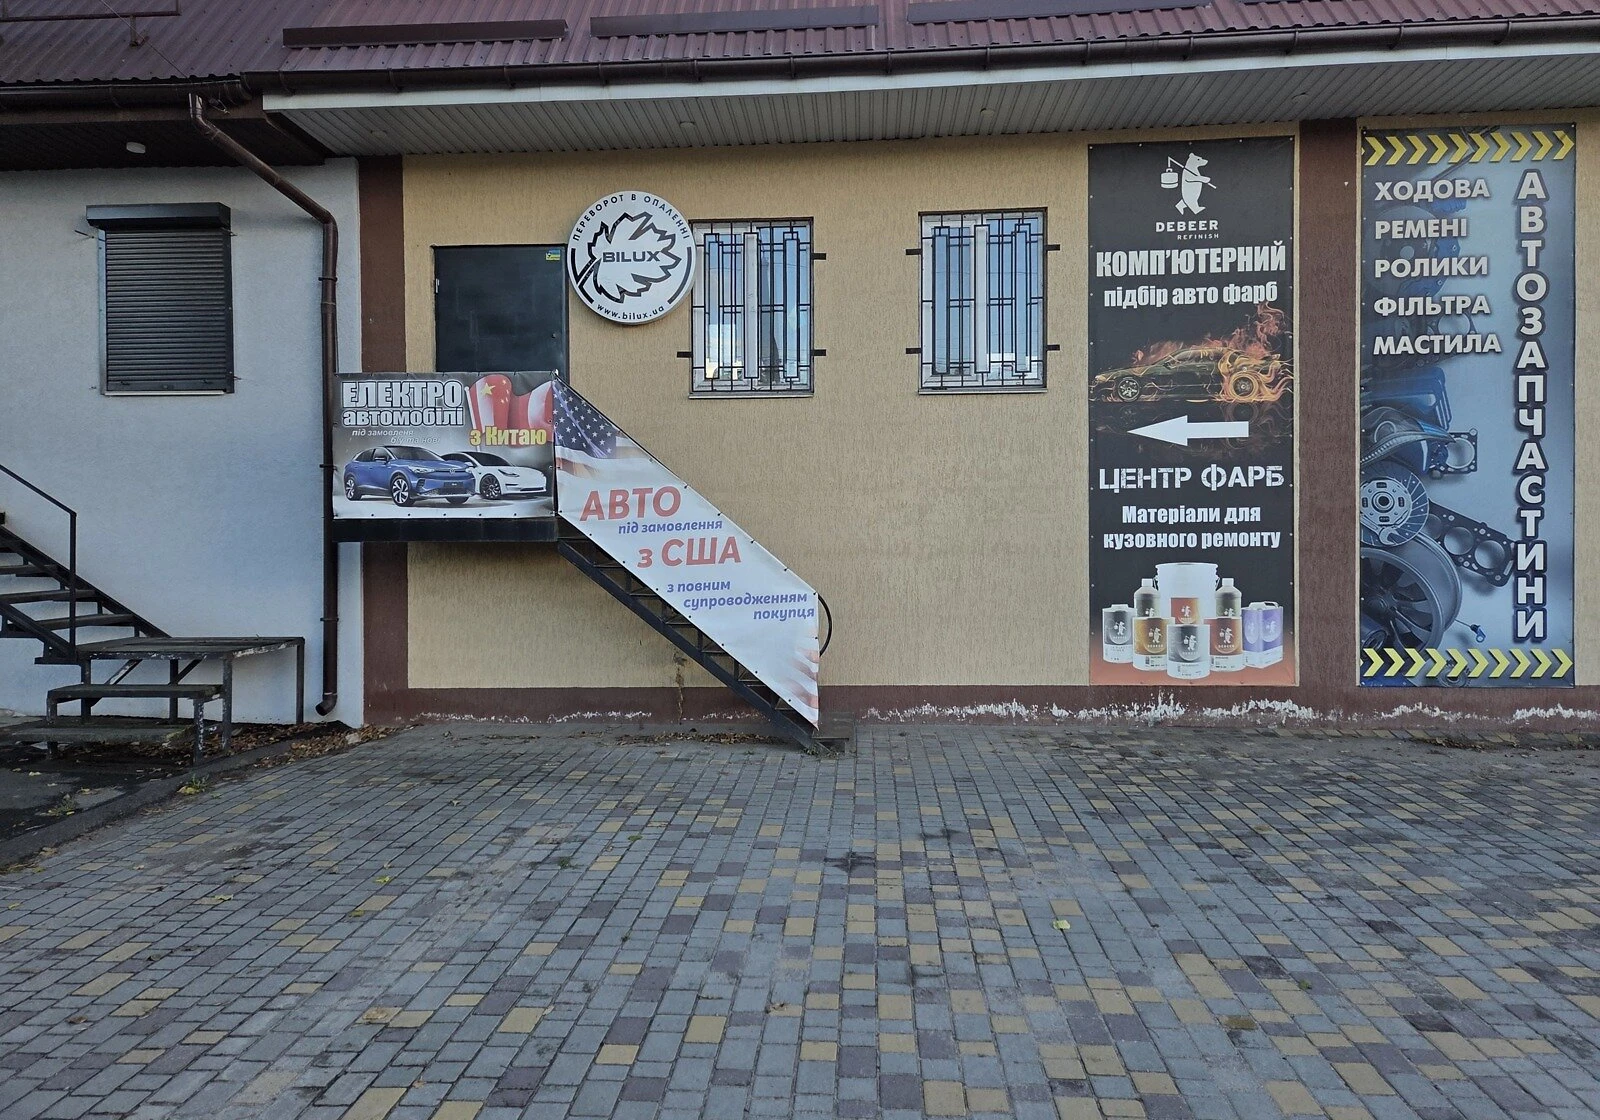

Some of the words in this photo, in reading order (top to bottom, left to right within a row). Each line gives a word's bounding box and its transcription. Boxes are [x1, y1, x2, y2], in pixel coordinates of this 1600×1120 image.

[1374, 178, 1491, 203] ХОДОВА
[572, 194, 625, 242] ПЕРЕВОРОТ
[631, 193, 637, 201] В
[643, 195, 691, 240] ОПАЛЕННІ
[1155, 219, 1219, 233] DEBEER
[1374, 218, 1467, 240] РЕМЕНІ
[602, 251, 661, 262] BILUX
[1374, 256, 1488, 278] РОЛИКИ
[1104, 285, 1168, 309] підбір
[1172, 286, 1219, 305] авто
[1223, 281, 1278, 305] фарб
[597, 304, 665, 320] www.bilux.ua
[1373, 295, 1491, 317] ФІЛЬТРА
[1373, 334, 1502, 355] МАСТИЛА
[341, 380, 464, 409] ЕЛЕКТРО
[1516, 171, 1547, 638] АВТОЗАПЧАСТИНИ
[343, 406, 465, 427] автомобілі
[352, 428, 366, 437] під
[469, 430, 481, 446] з
[485, 425, 547, 446] Китаю
[1099, 467, 1193, 494] ЦЕНТР
[1200, 463, 1286, 492] ФАРБ
[579, 485, 681, 522] АВТО
[1122, 505, 1221, 525] Матеріали
[1224, 506, 1261, 525] для
[618, 522, 639, 535] під
[641, 519, 723, 533] замовлення
[1103, 532, 1198, 549] кузовного
[1201, 531, 1282, 549] ремонту
[636, 548, 653, 568] з
[661, 535, 742, 567] США
[667, 583, 674, 592] з
[677, 579, 731, 592] повним
[683, 592, 807, 610] супроводженням
[753, 606, 815, 621] покупця
